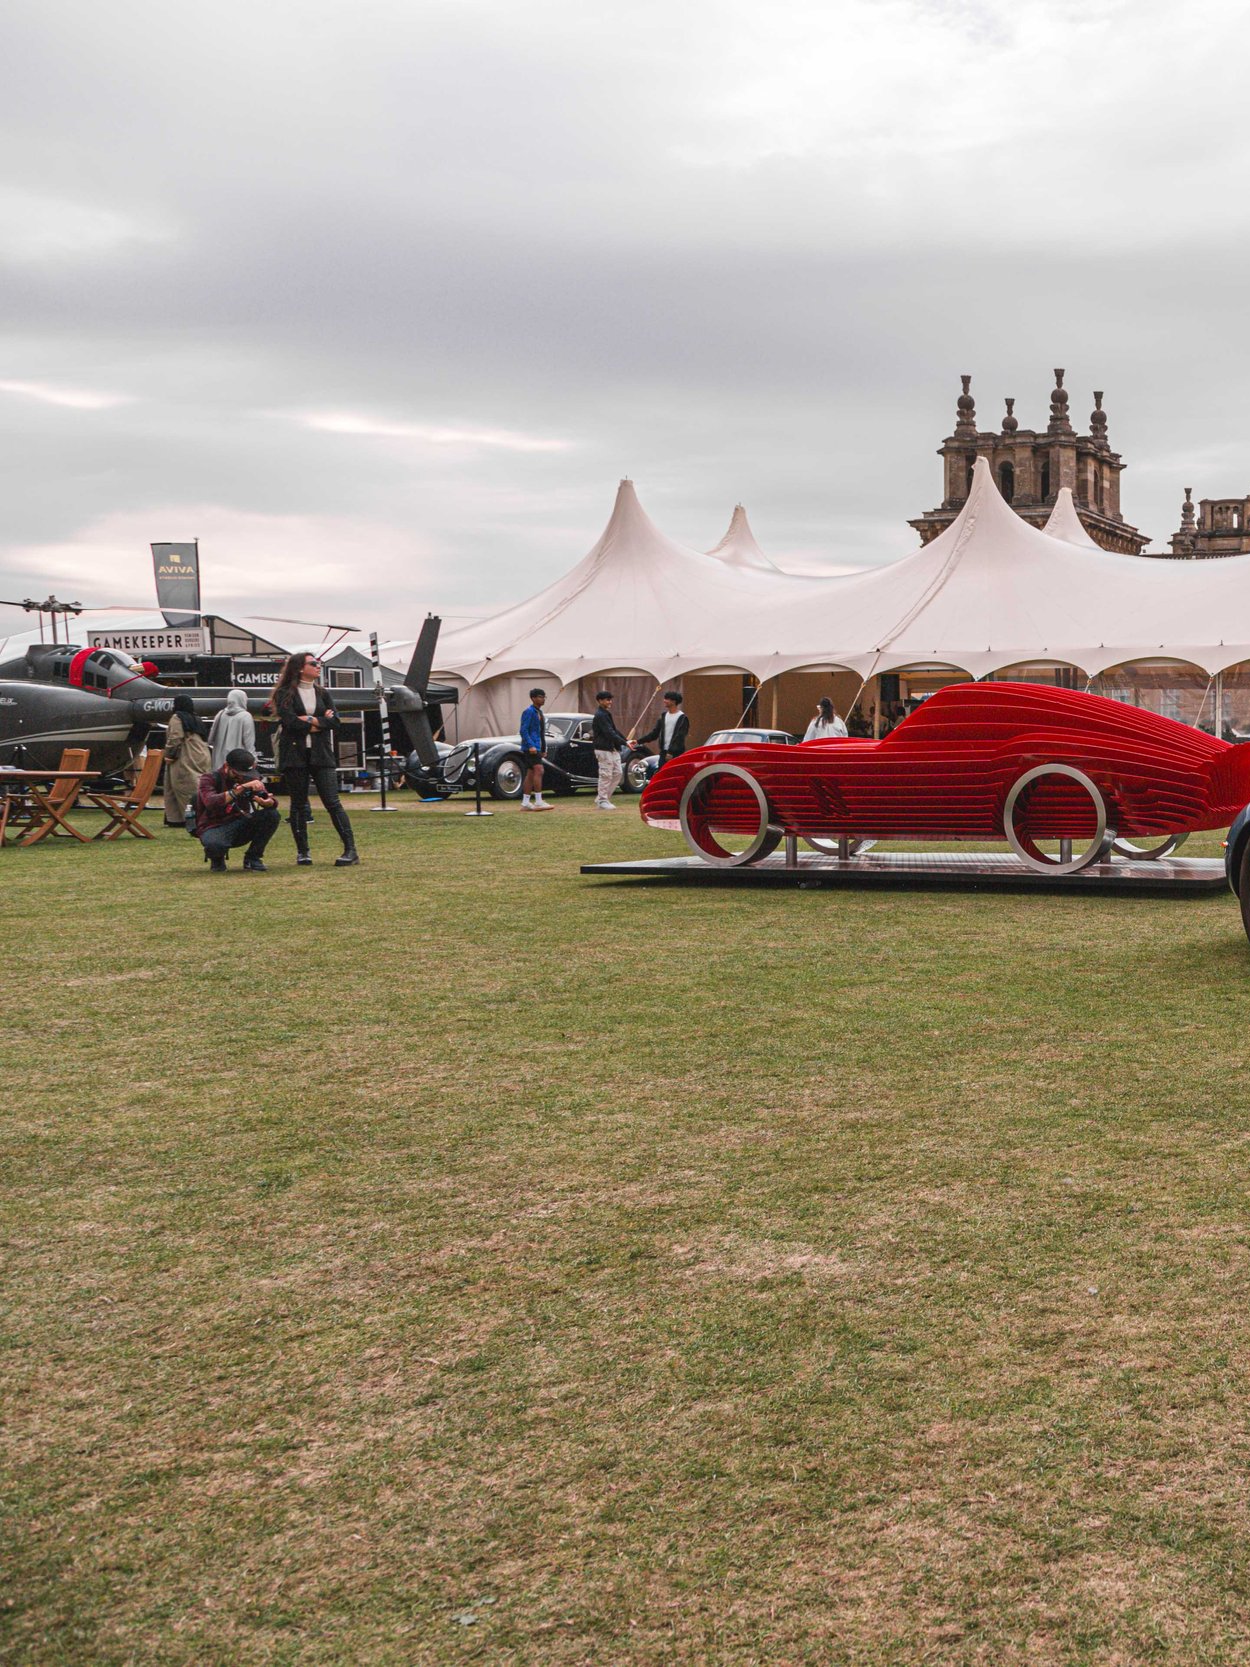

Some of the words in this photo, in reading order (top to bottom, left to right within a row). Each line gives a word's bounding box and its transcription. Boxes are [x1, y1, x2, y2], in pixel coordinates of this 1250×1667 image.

[93, 634, 183, 649] GAMEKEEPER
[236, 673, 282, 684] GAMEKE
[143, 701, 175, 712] G-WO
